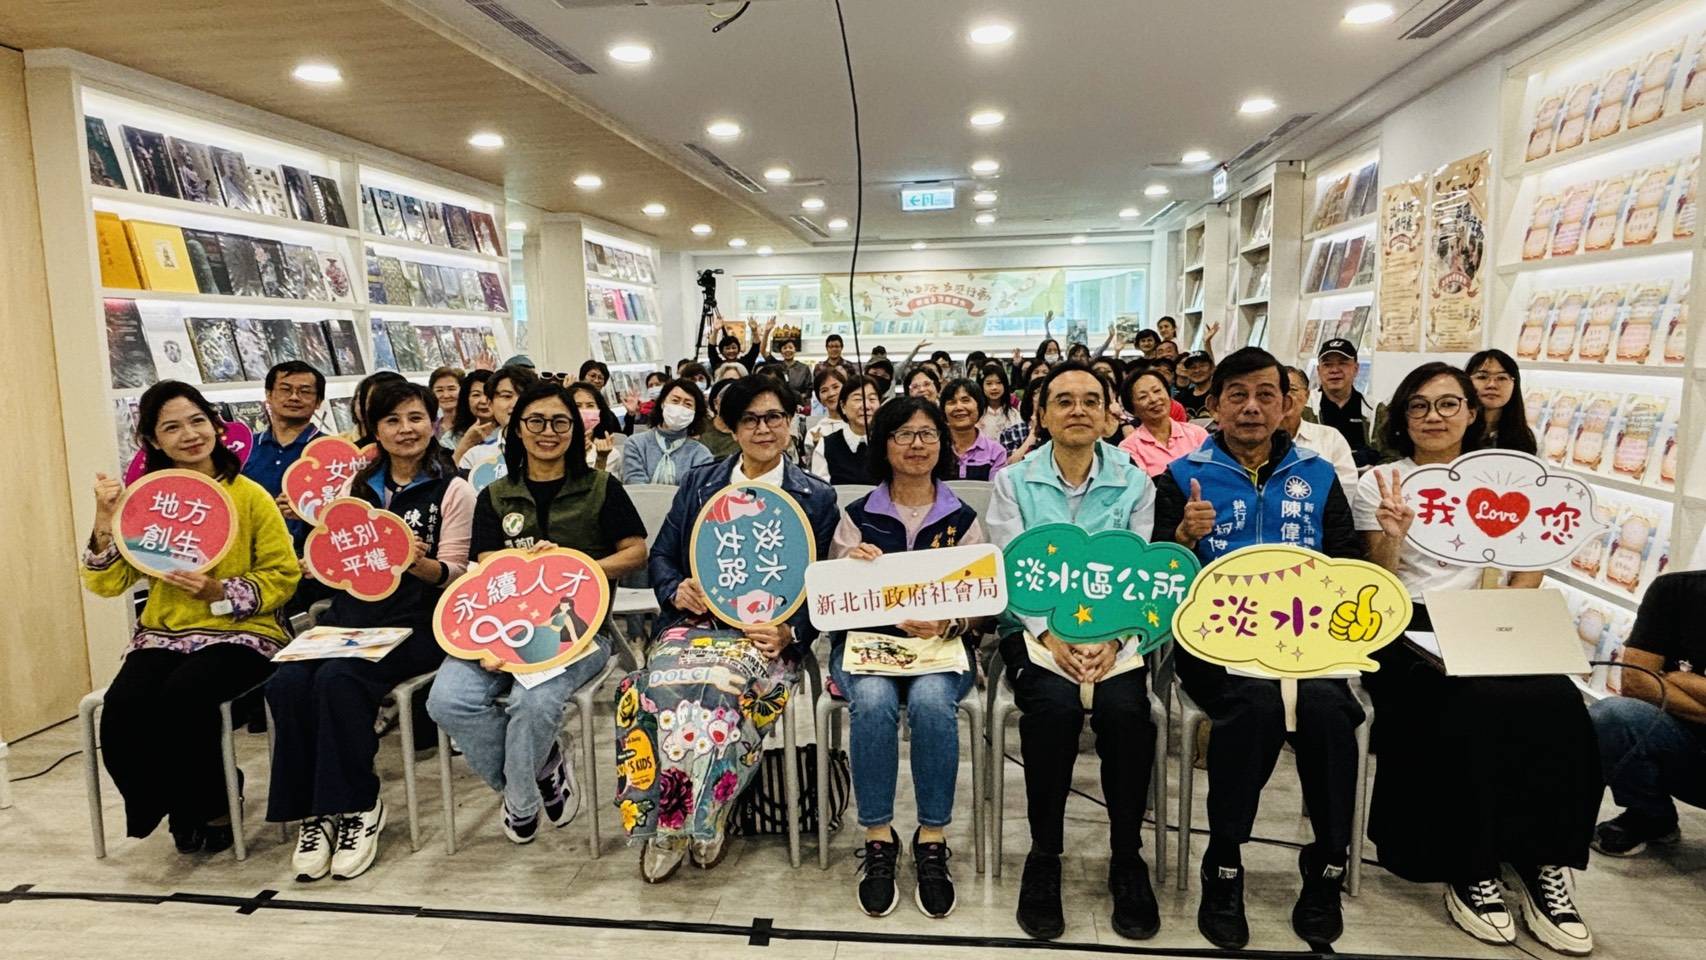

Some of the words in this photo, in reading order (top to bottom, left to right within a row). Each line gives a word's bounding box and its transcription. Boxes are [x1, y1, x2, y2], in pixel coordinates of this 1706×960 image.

[150, 490, 211, 525] 地方
[1280, 500, 1302, 547] 陳偉
[1303, 502, 1315, 550] 新北市議
[1417, 487, 1461, 526] 我
[1475, 501, 1520, 523] Love
[1535, 501, 1581, 545] 您
[138, 523, 201, 559] 創生
[330, 520, 379, 552] 性別
[713, 525, 748, 590] 女路
[752, 518, 787, 586] 淡水
[341, 548, 391, 577] 平權
[1015, 558, 1186, 604] 淡水區公所
[452, 563, 591, 624] 永續人才
[817, 576, 999, 616] 新北市政府社會局
[1209, 595, 1323, 637] 淡水
